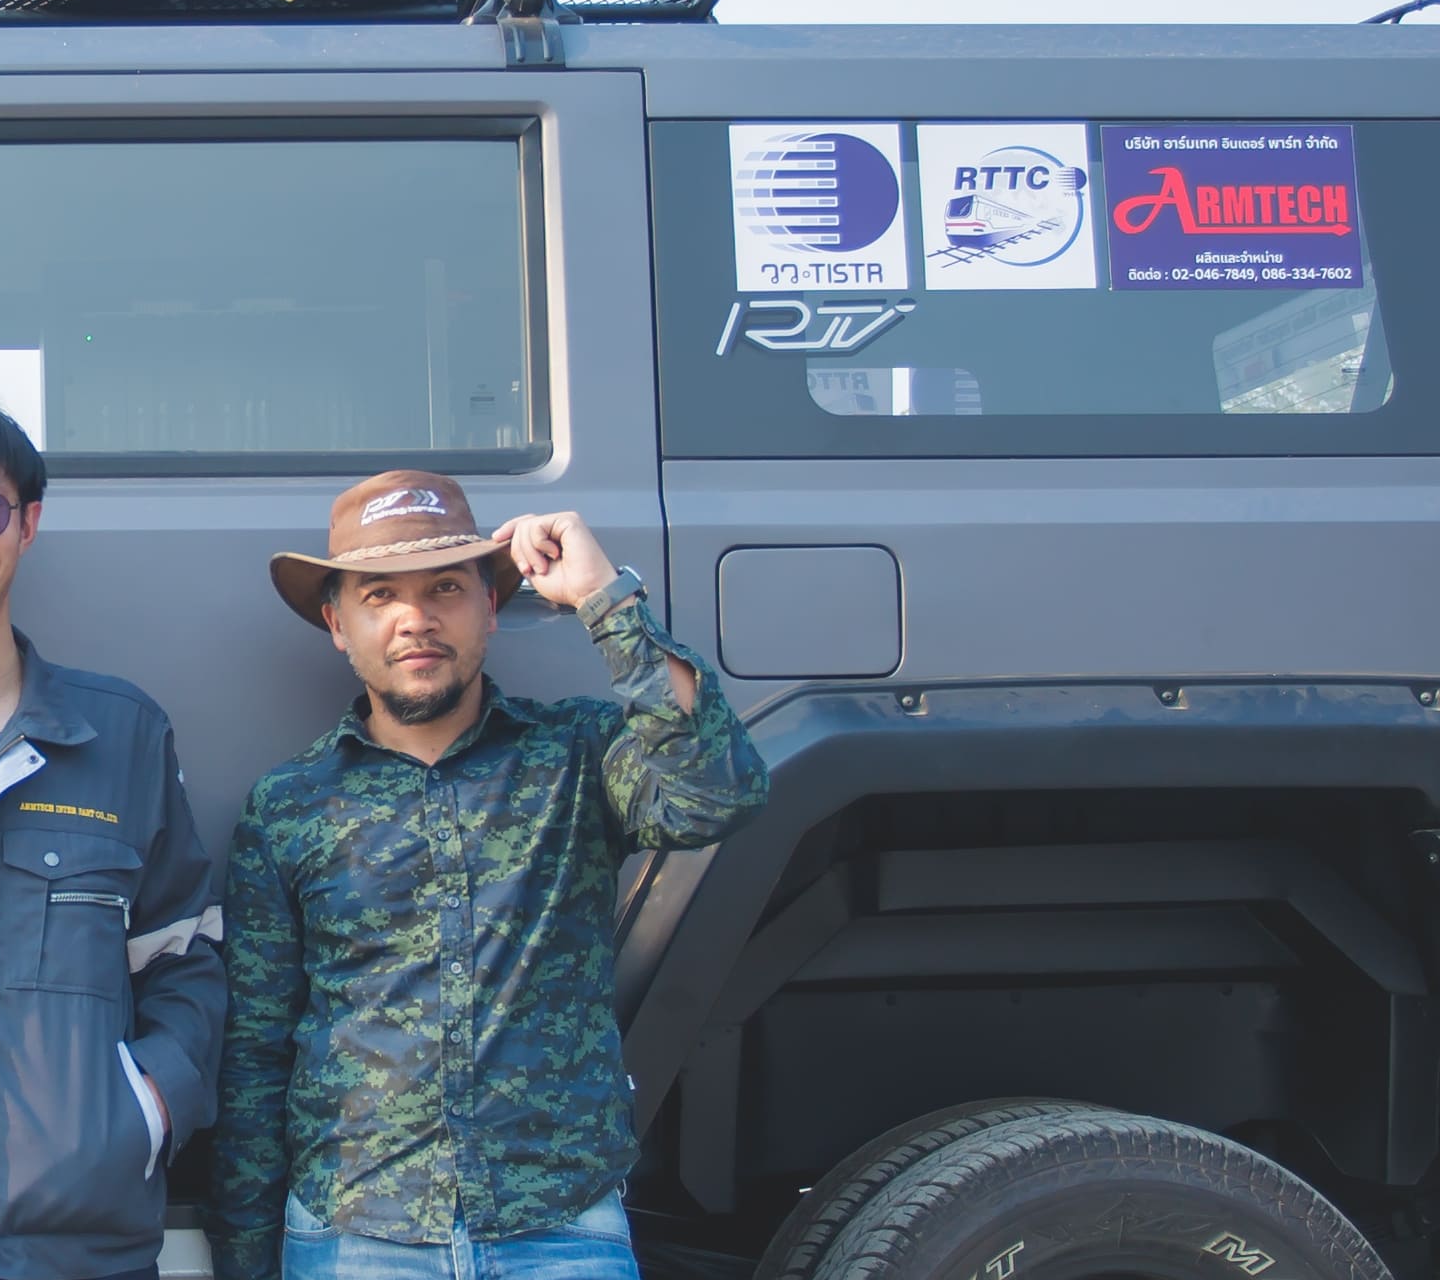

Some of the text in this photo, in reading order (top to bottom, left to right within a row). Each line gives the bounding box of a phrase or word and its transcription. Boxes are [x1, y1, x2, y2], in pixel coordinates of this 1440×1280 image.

[1124, 135, 1338, 150] บริษัท อาร์มเทค อินเตอร์ พาร์ท จำกัด
[953, 165, 1050, 191] RTTC
[1113, 167, 1351, 235] ARMTECH
[1195, 250, 1283, 264] ผลิตและจำหน่าย
[1128, 267, 1162, 281] ติดต่อ
[1261, 267, 1352, 281] 086-334-7602
